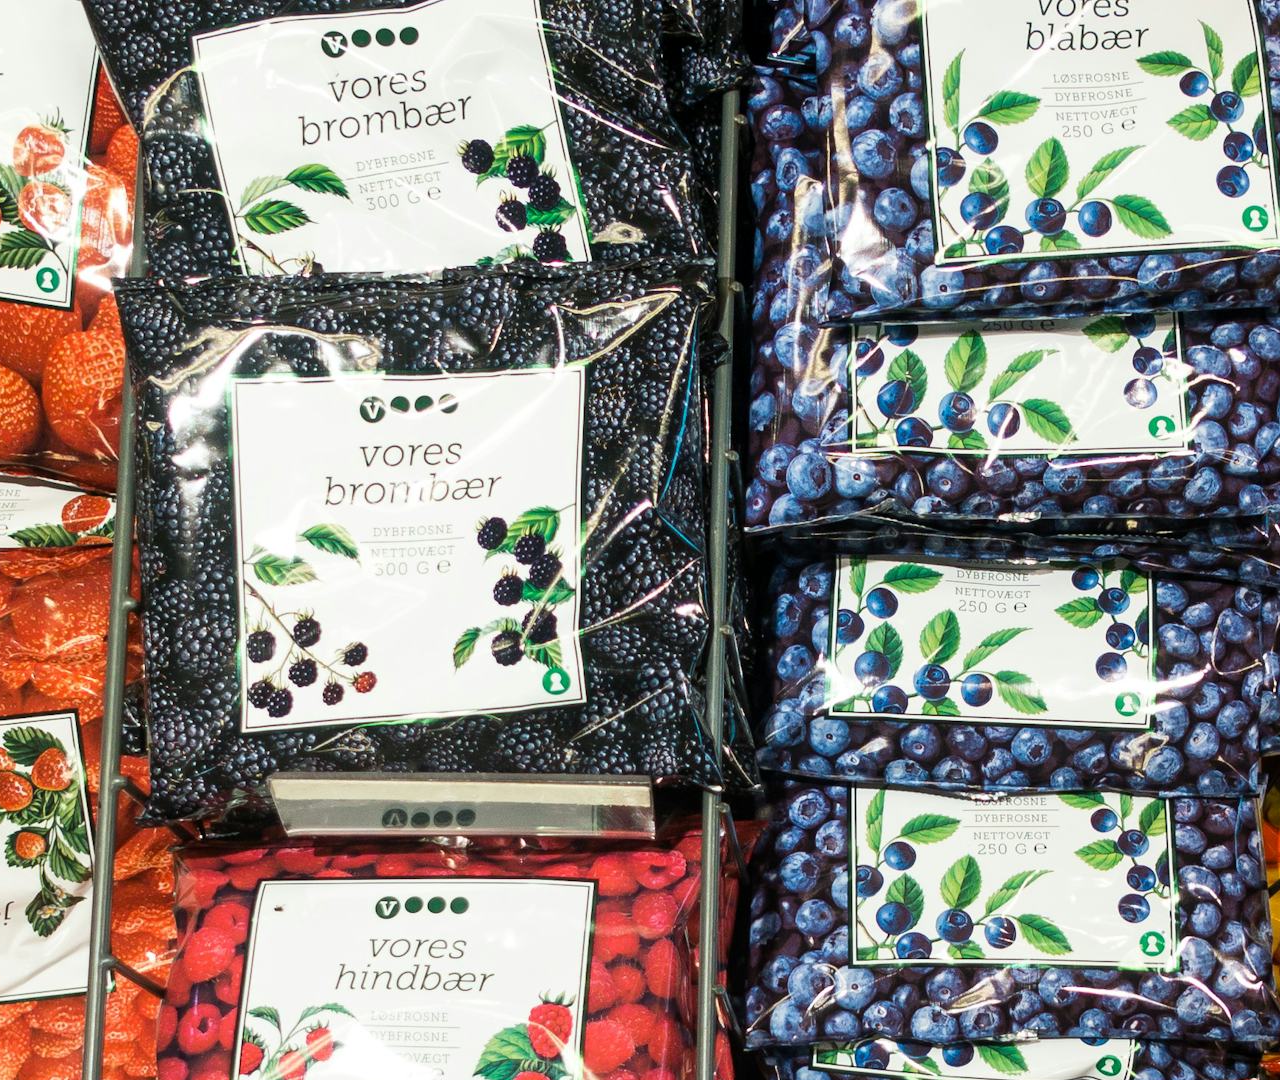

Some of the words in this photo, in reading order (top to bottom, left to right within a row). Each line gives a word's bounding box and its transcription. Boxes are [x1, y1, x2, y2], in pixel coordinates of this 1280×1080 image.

[1038, 0, 1130, 18] vores
[1026, 22, 1150, 52] blåbær
[1053, 71, 1131, 83] LØSFROSNE
[329, 70, 428, 102] vores
[1054, 88, 1134, 102] DYBFROSNE
[299, 96, 472, 146] brombær
[1055, 105, 1139, 122] NETTOVÆGT
[1062, 124, 1094, 138] 250
[356, 150, 435, 173] DYBFROSNE
[366, 193, 400, 211] 300
[360, 442, 462, 468] vores
[324, 474, 502, 506] brombær
[372, 524, 454, 537] DYBFROSNE
[370, 546, 456, 558] NETTOVÆGT
[957, 570, 1029, 581] DYBFROSNE
[955, 587, 1031, 599] NETTOVÆGT
[959, 600, 987, 613] 250
[975, 814, 1048, 822] DYBFROSNE
[973, 832, 1050, 840] NETTOVÆGT
[977, 844, 1007, 855] 250
[369, 936, 467, 959] vores
[334, 964, 495, 993] hindbær
